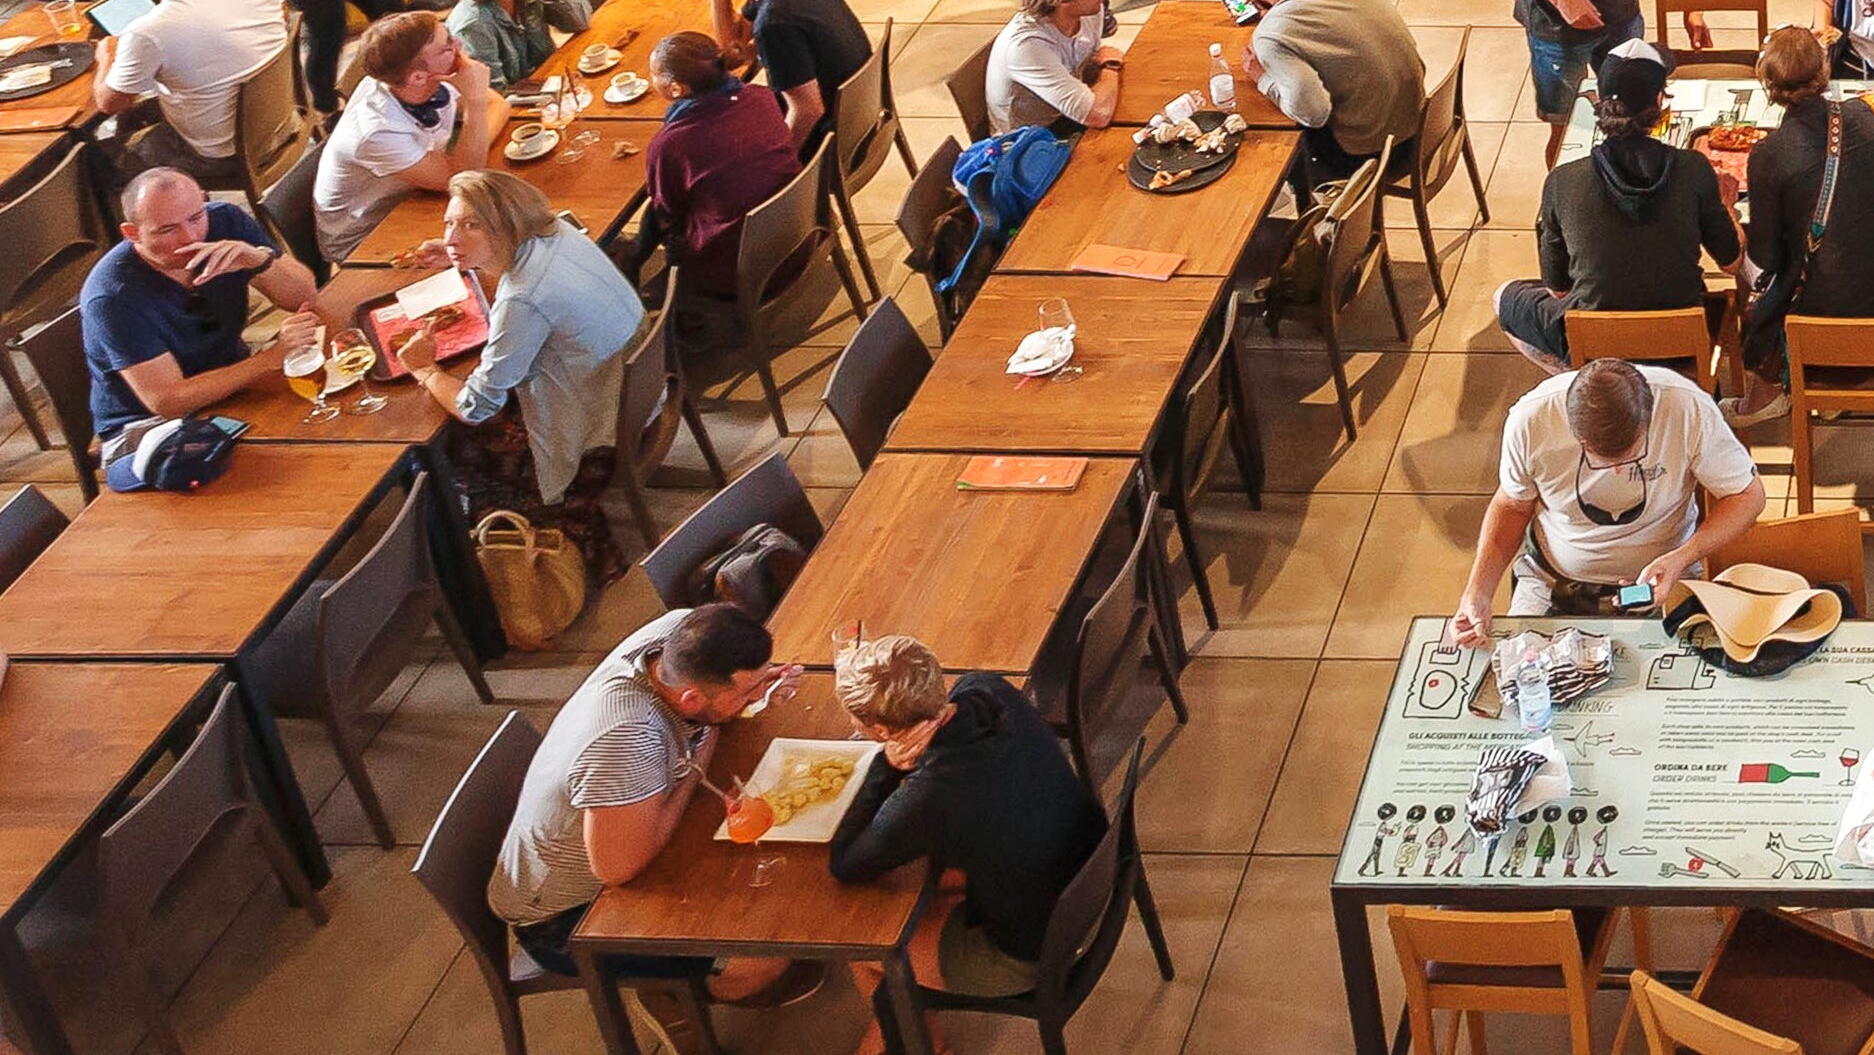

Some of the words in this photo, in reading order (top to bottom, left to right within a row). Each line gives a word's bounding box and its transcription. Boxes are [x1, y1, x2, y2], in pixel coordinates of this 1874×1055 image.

[1409, 732, 1423, 740] GLI
[1425, 732, 1466, 740] ACQUISTI
[1468, 732, 1489, 740] ALLE
[1491, 732, 1530, 740] BOTTEG
